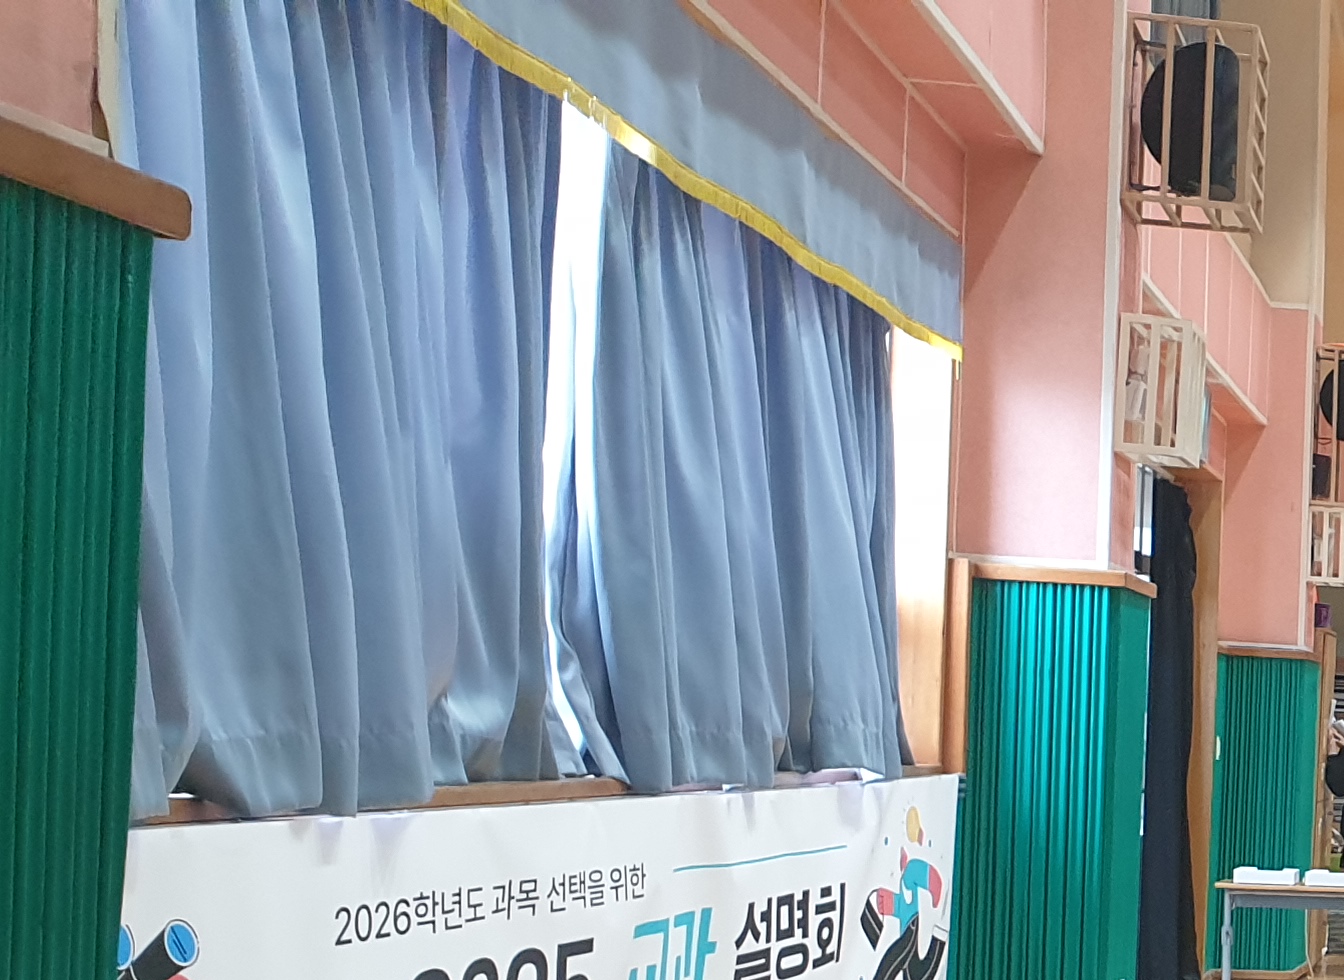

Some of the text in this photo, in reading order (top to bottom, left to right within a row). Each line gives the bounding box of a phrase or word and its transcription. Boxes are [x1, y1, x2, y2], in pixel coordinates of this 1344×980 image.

[334, 862, 647, 946] 2026학년도 과목 선택을 위한
